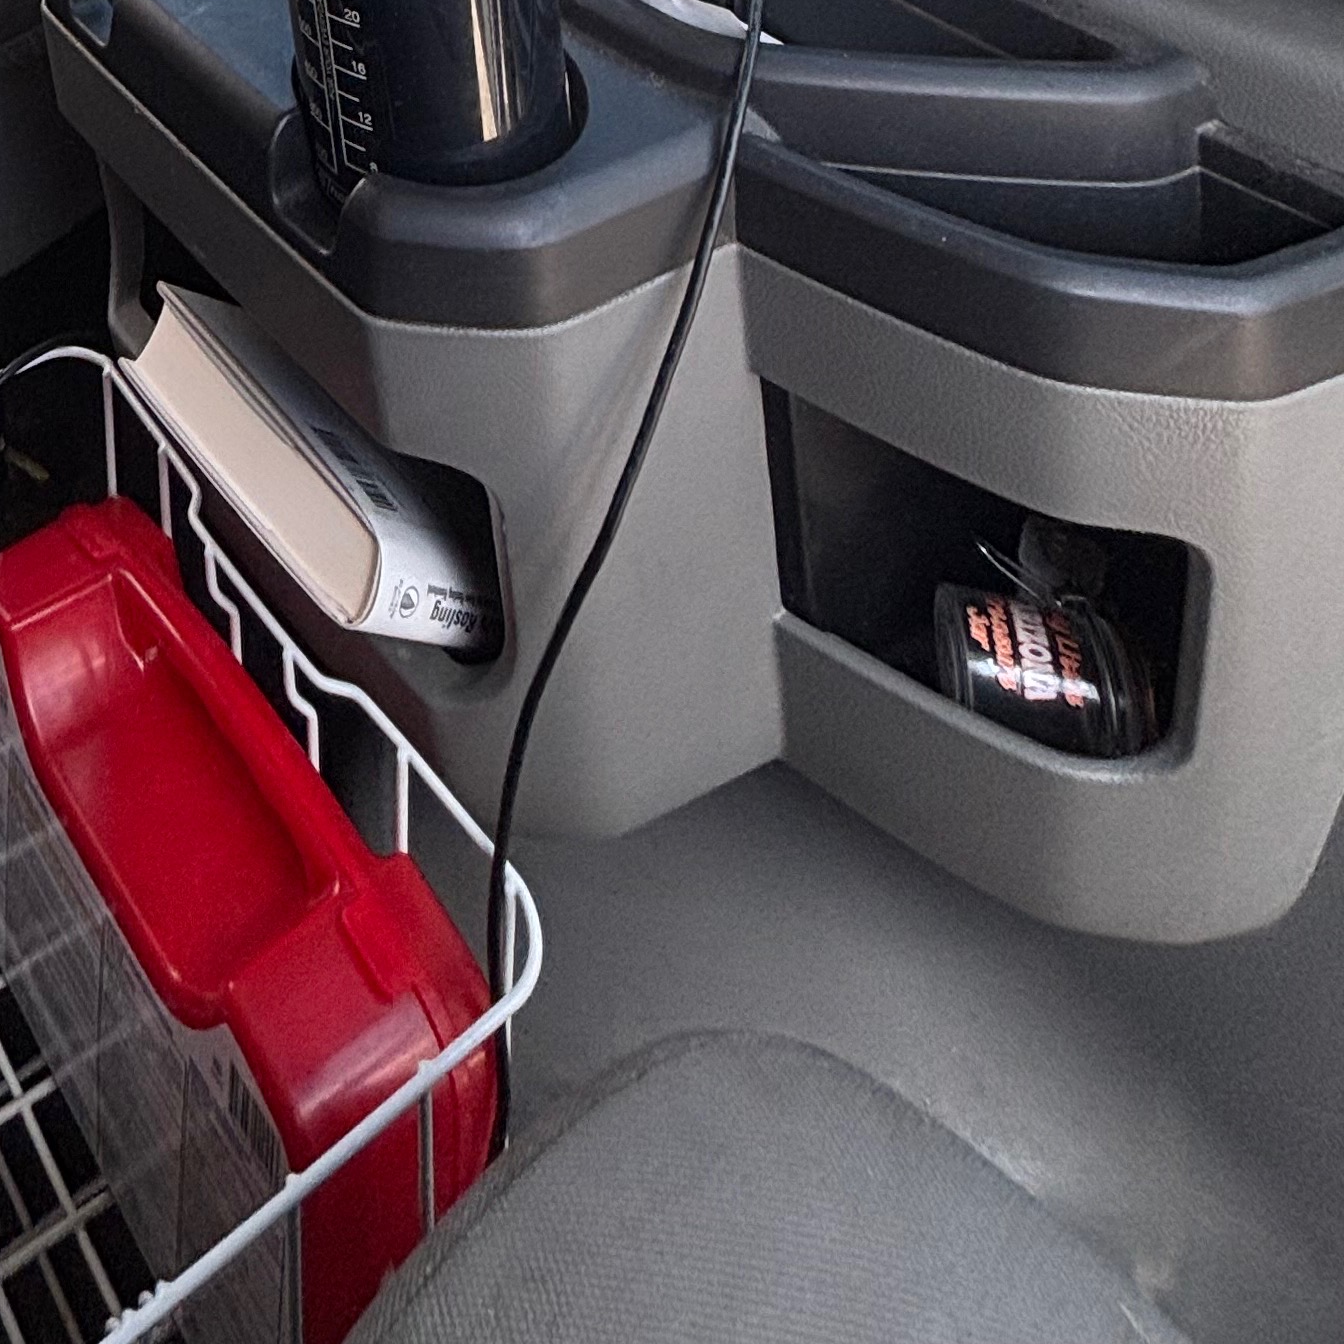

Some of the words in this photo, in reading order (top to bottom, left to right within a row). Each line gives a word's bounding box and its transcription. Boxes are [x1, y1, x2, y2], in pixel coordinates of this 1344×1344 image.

[343, 8, 360, 23] 20
[351, 60, 367, 75] 16
[358, 111, 372, 126] 12
[429, 600, 477, 633] Rosling
